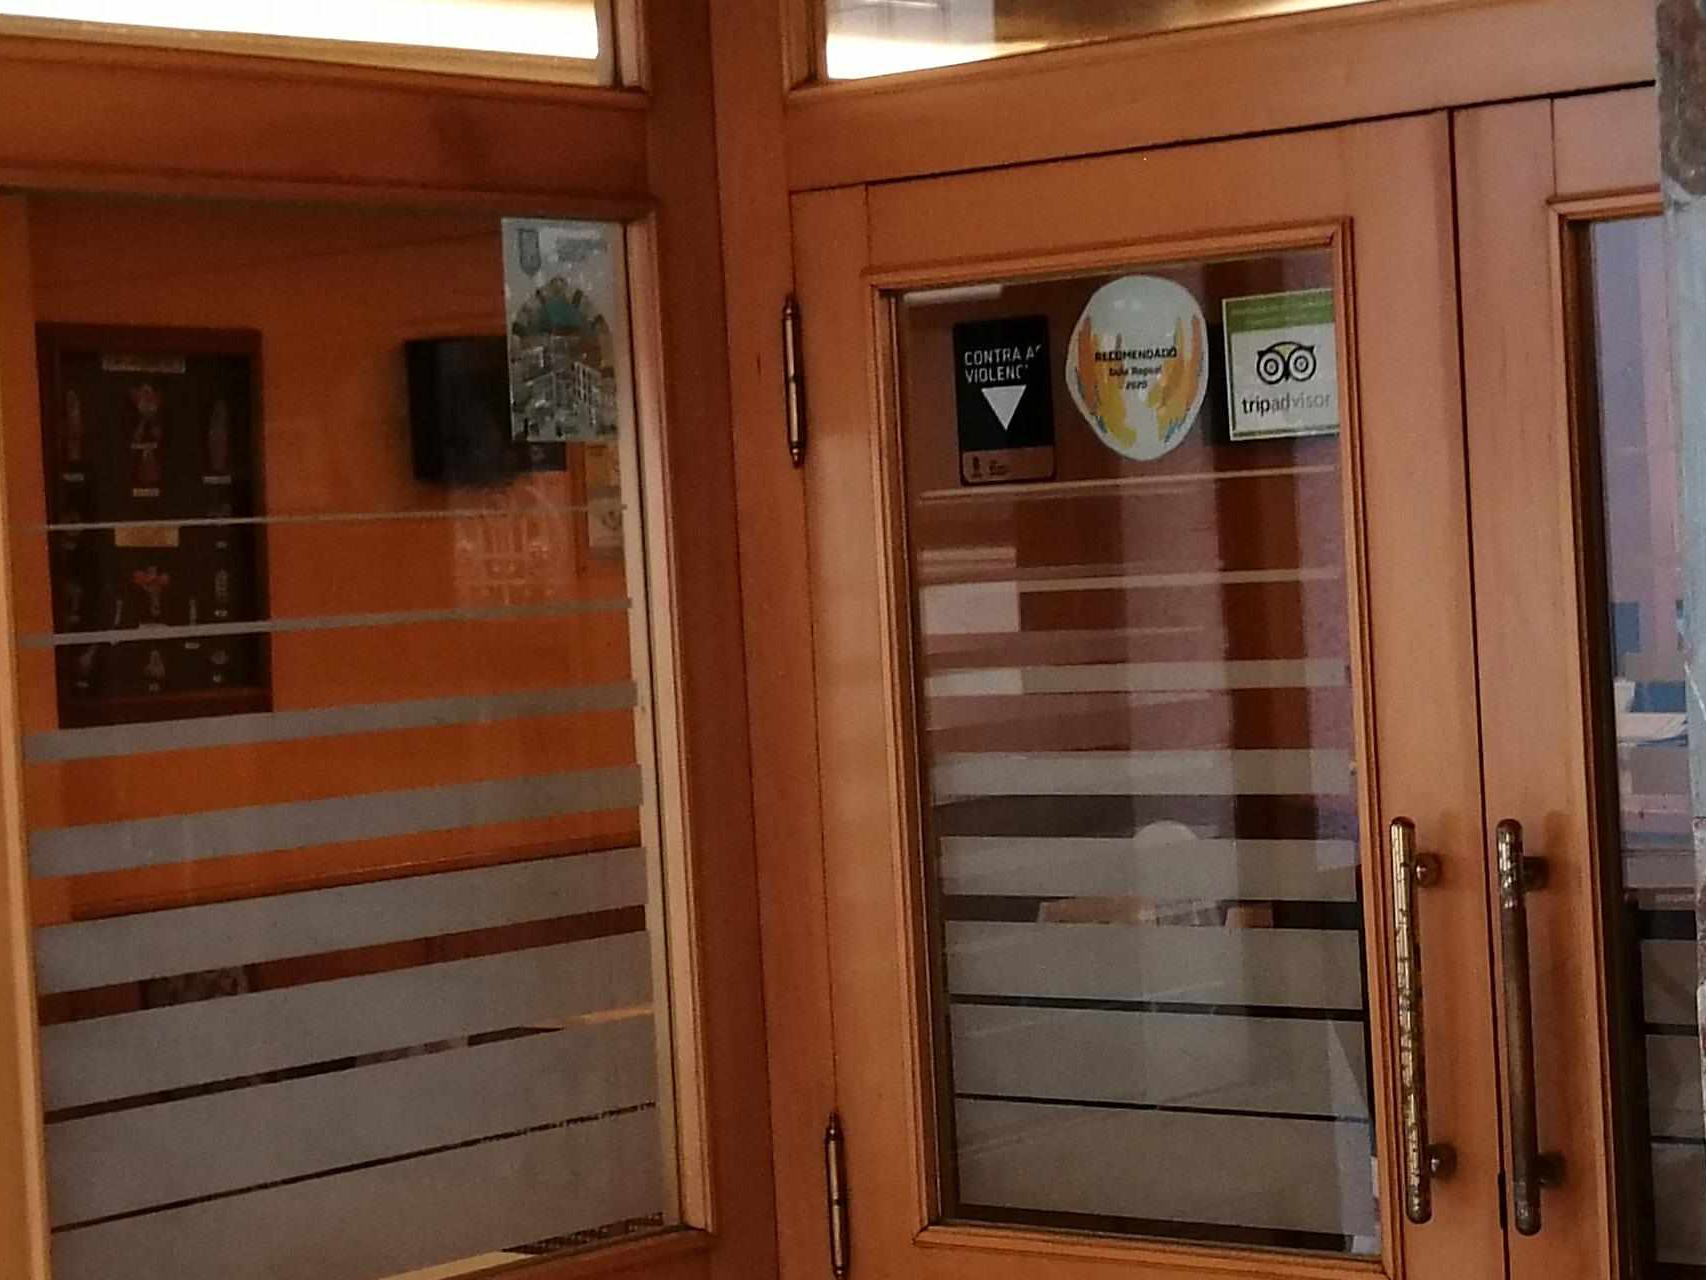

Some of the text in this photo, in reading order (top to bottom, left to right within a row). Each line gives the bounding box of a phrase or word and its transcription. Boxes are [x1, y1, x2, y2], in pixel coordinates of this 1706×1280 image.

[964, 345, 1022, 366] CONTRA
[965, 363, 1029, 384] VIOLENC
[1242, 392, 1331, 417] tripadvisor
